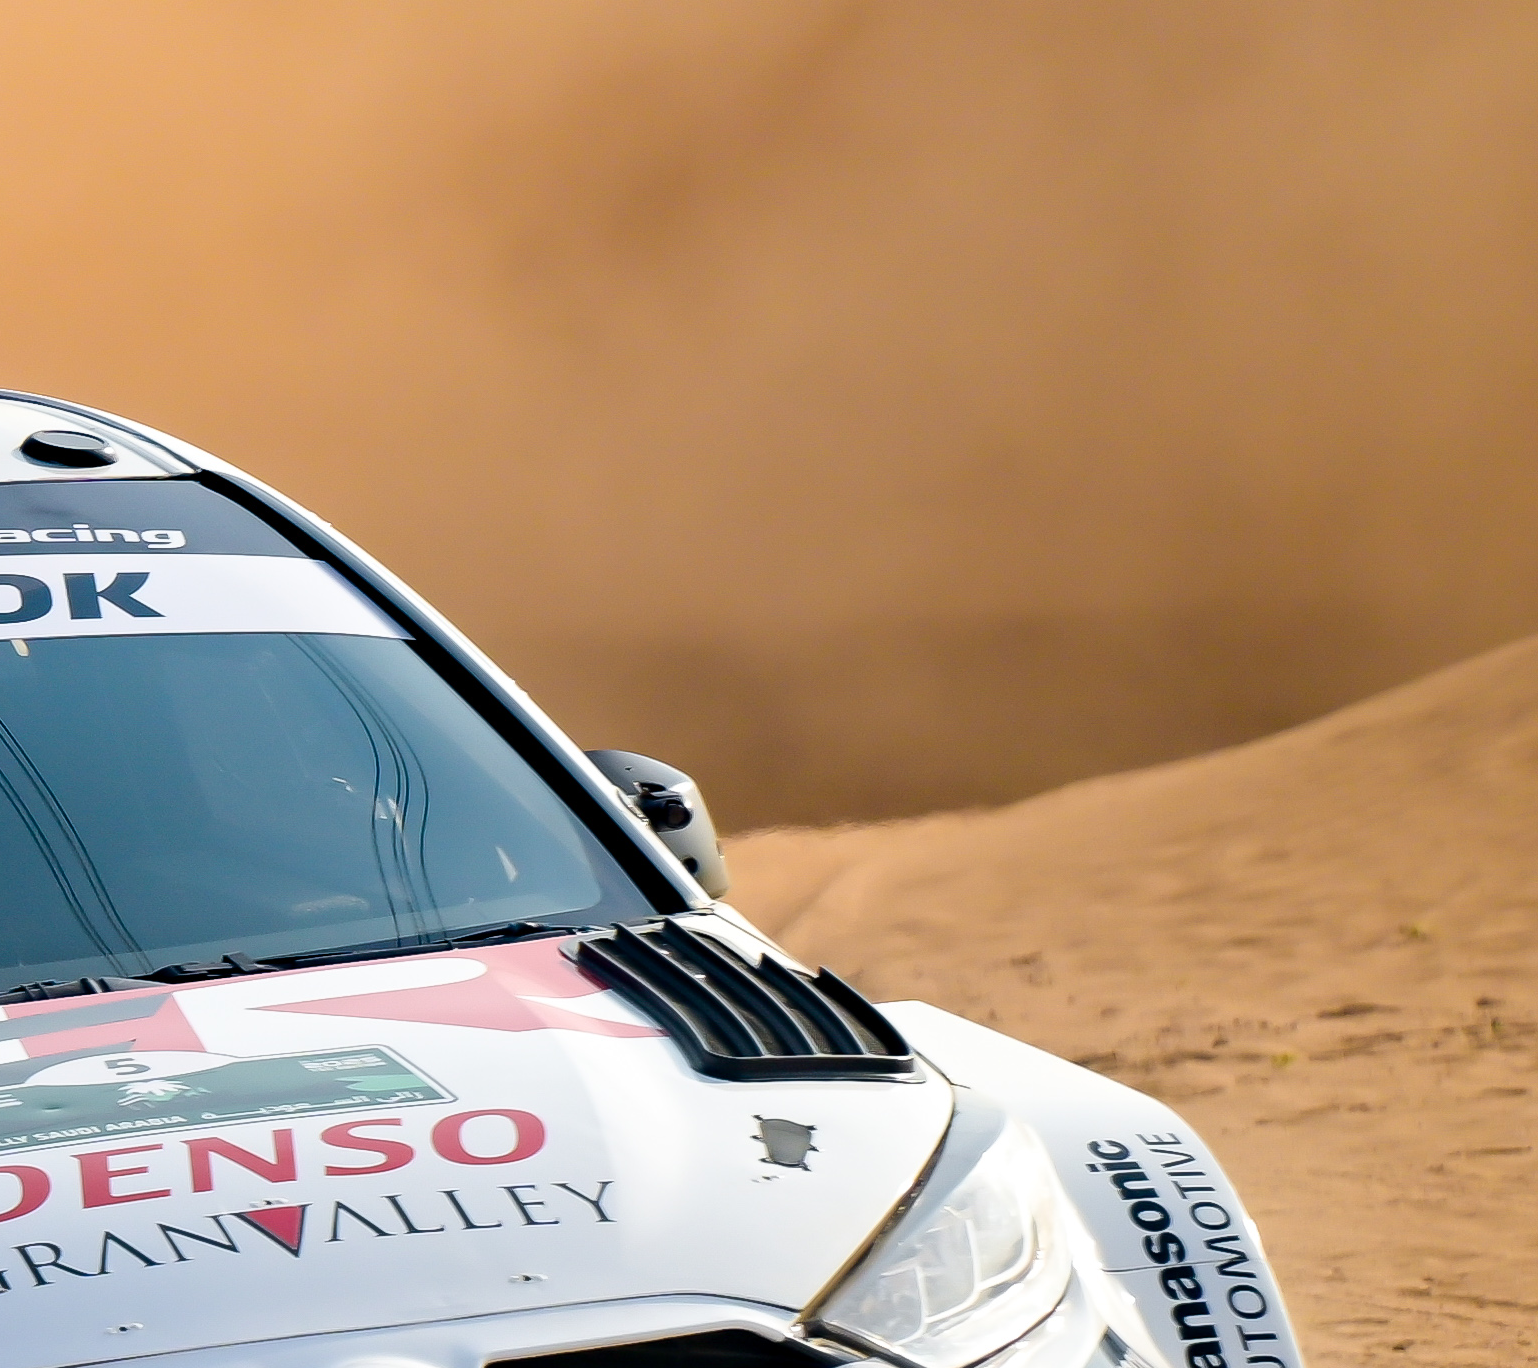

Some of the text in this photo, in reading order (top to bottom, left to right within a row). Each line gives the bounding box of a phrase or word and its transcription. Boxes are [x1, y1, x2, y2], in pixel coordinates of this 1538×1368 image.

[103, 1057, 151, 1076] 5
[31, 1125, 102, 1142] SAUDI
[104, 1115, 188, 1133] ARABIA
